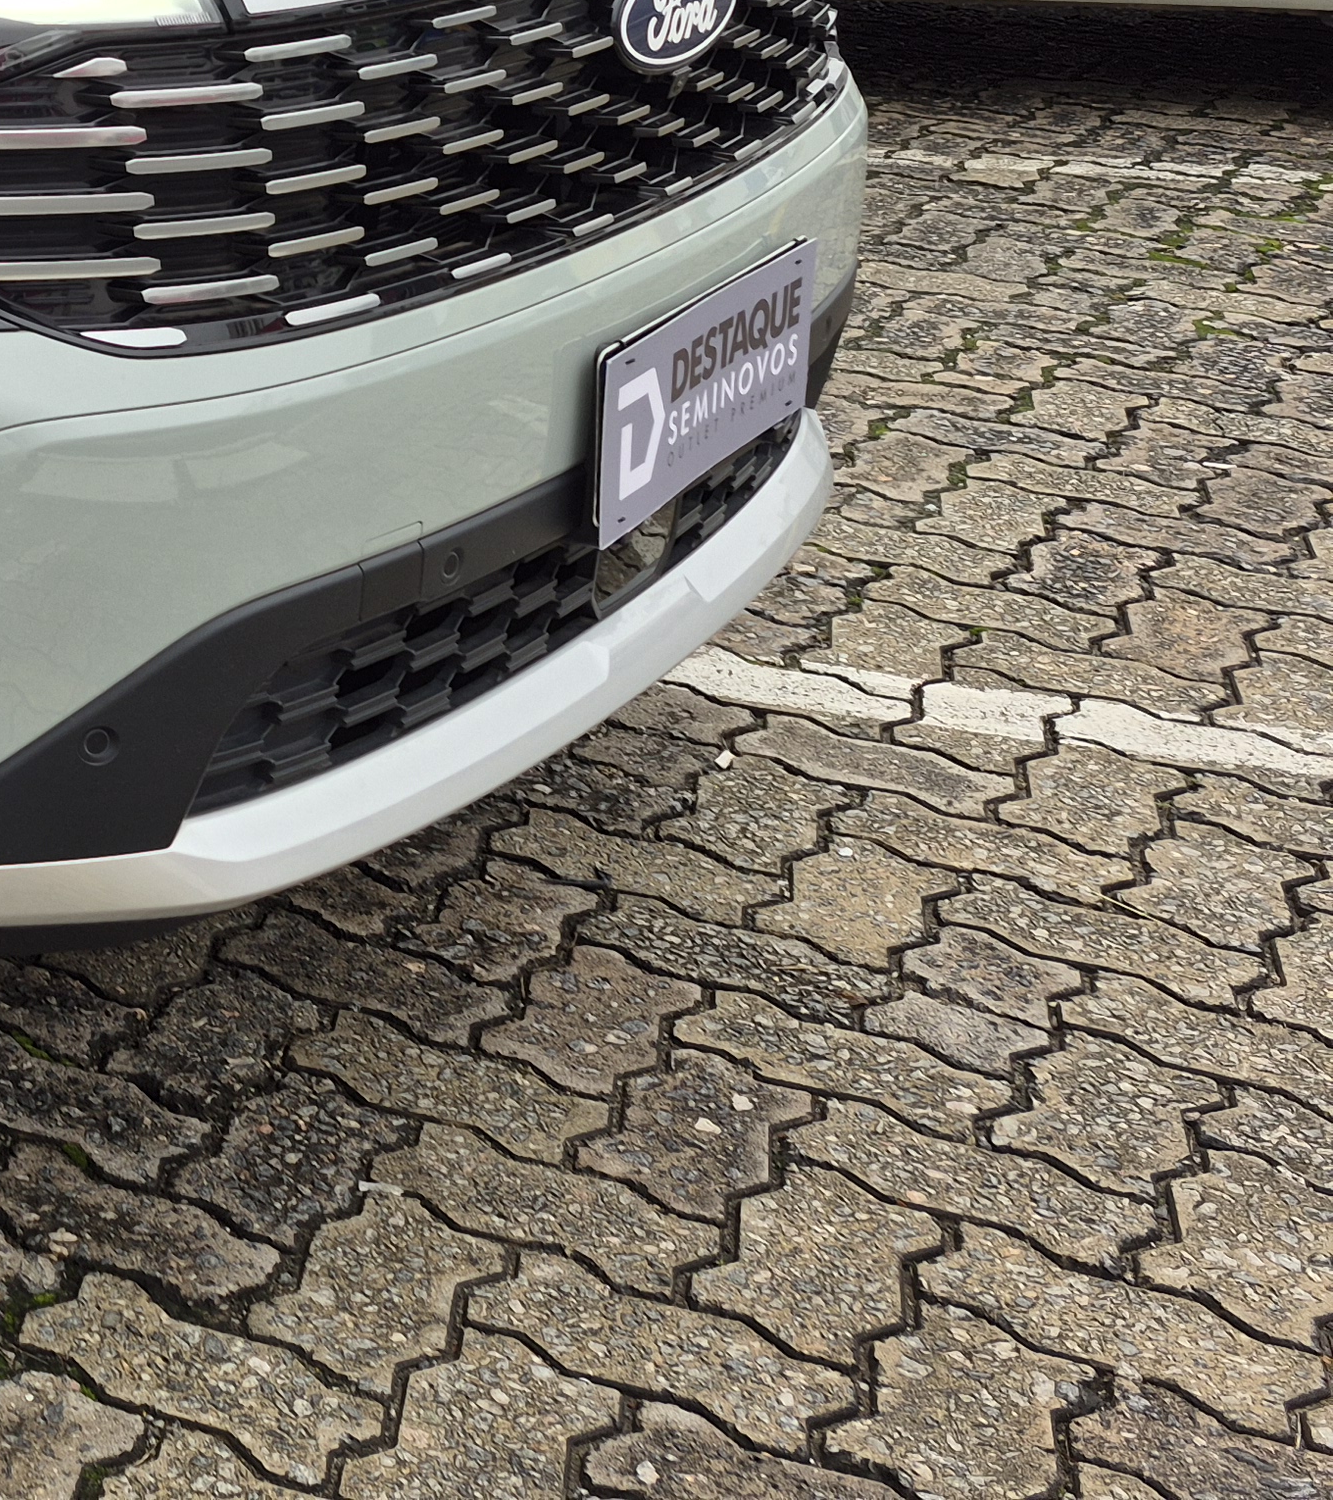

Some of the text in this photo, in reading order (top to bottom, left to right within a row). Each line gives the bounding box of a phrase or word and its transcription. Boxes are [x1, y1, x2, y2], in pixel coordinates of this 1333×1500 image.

[667, 333, 799, 446] SEMINOVOS
[670, 276, 803, 404] DESTAQUE
[666, 370, 796, 468] OUTLET PREMIUM
